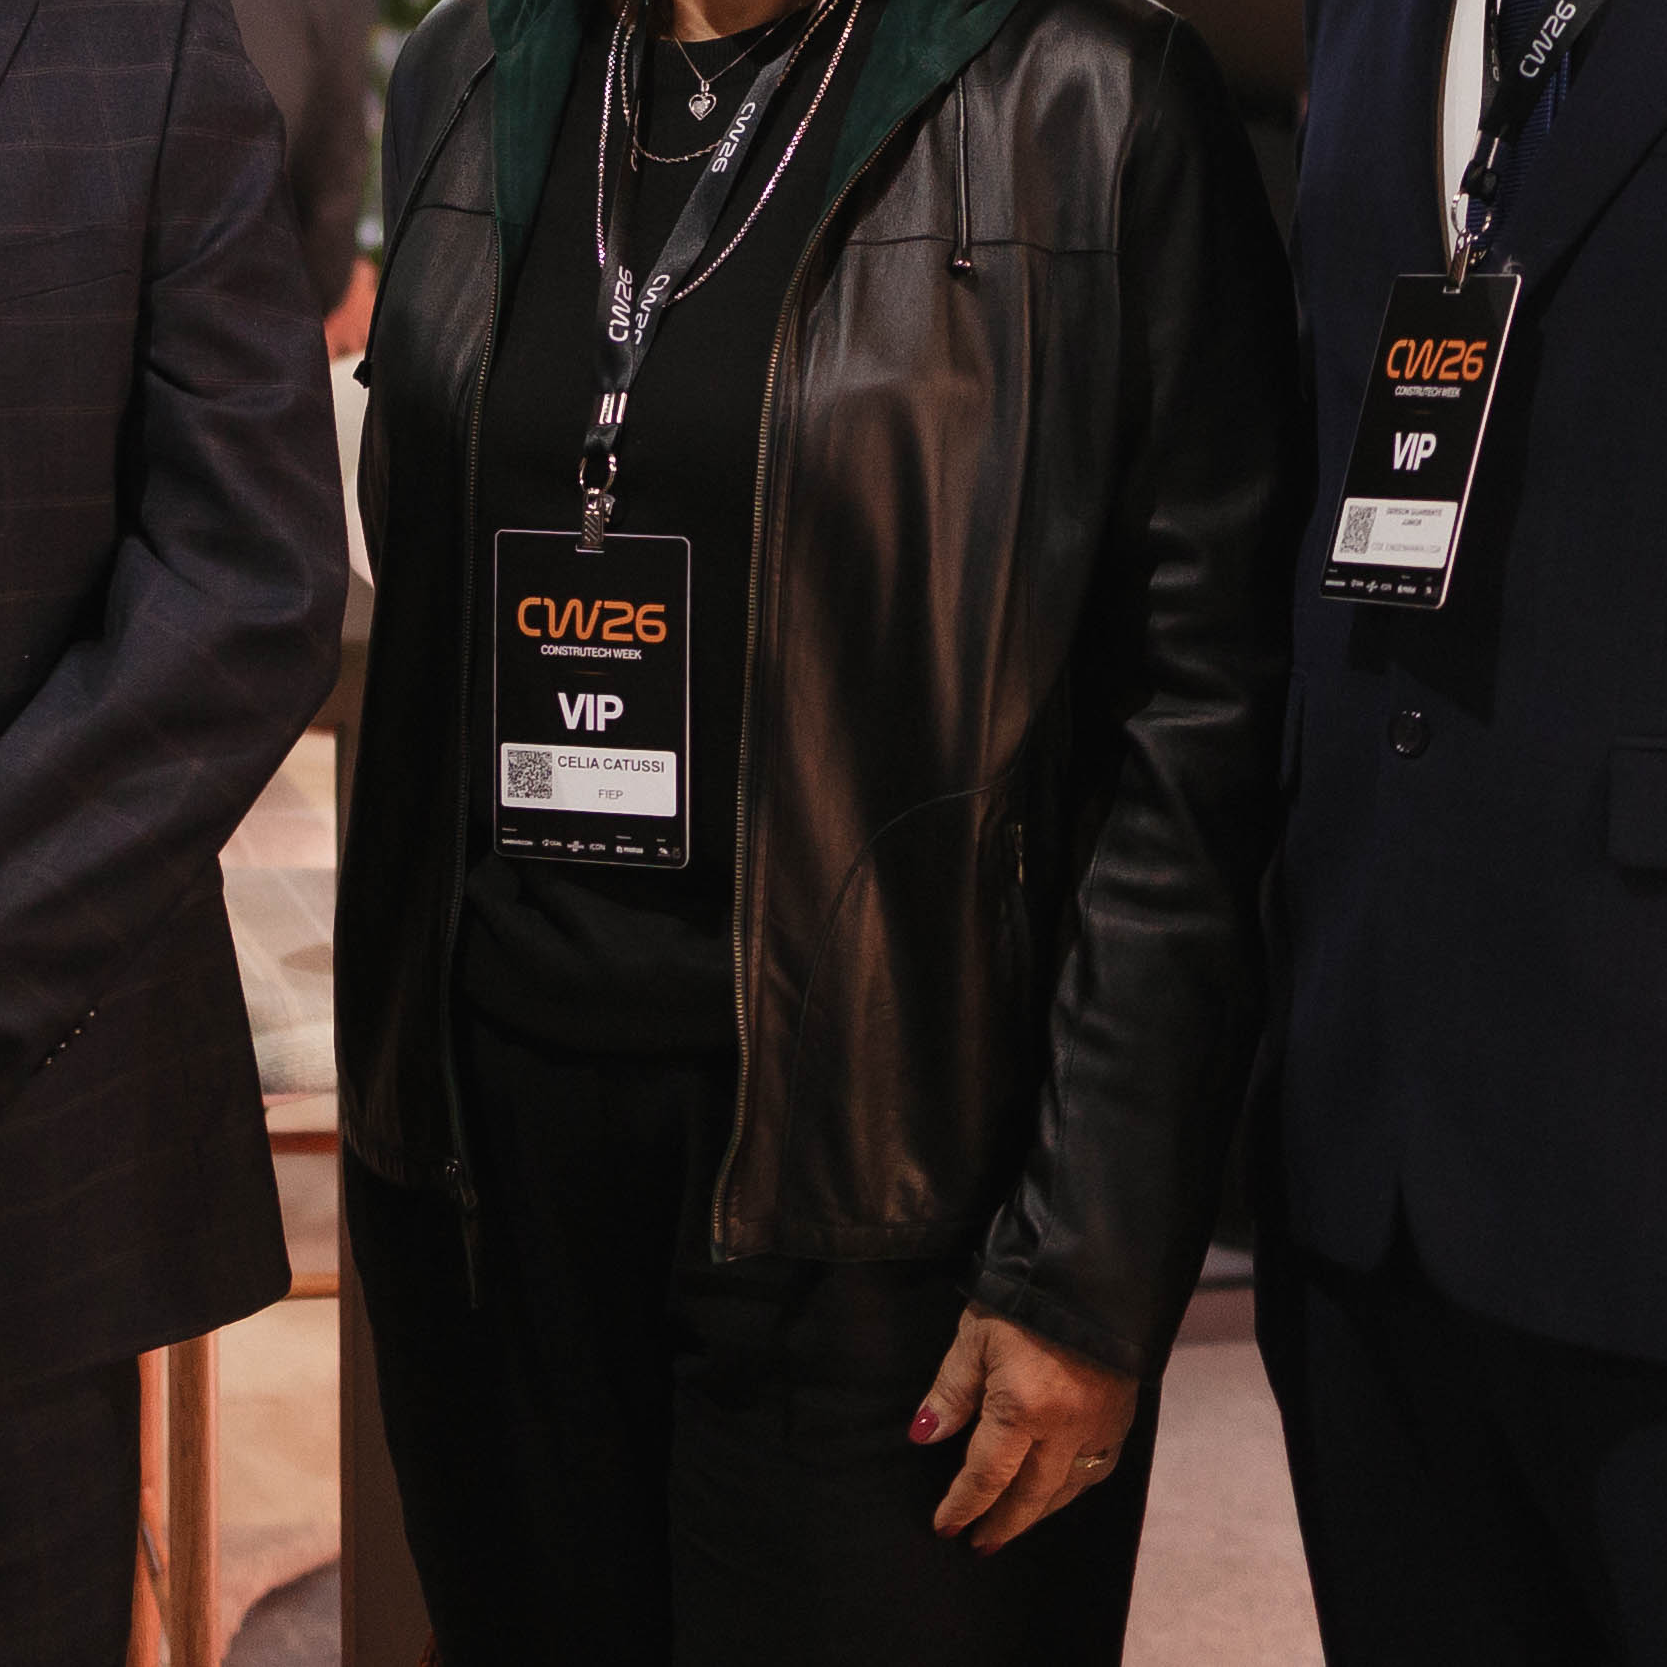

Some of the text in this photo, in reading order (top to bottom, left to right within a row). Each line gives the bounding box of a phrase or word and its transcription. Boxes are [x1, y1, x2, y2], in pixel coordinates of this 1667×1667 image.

[711, 102, 756, 173] CW26
[608, 265, 633, 342] CW26
[1387, 339, 1488, 381] CW26
[1392, 432, 1437, 471] VIP
[517, 597, 667, 644] CW26
[540, 644, 642, 660] CONSTRUTECH WEEK
[557, 692, 624, 732] VIP
[557, 755, 665, 773] CELIA CATUSSI
[598, 788, 624, 800] FIEP
